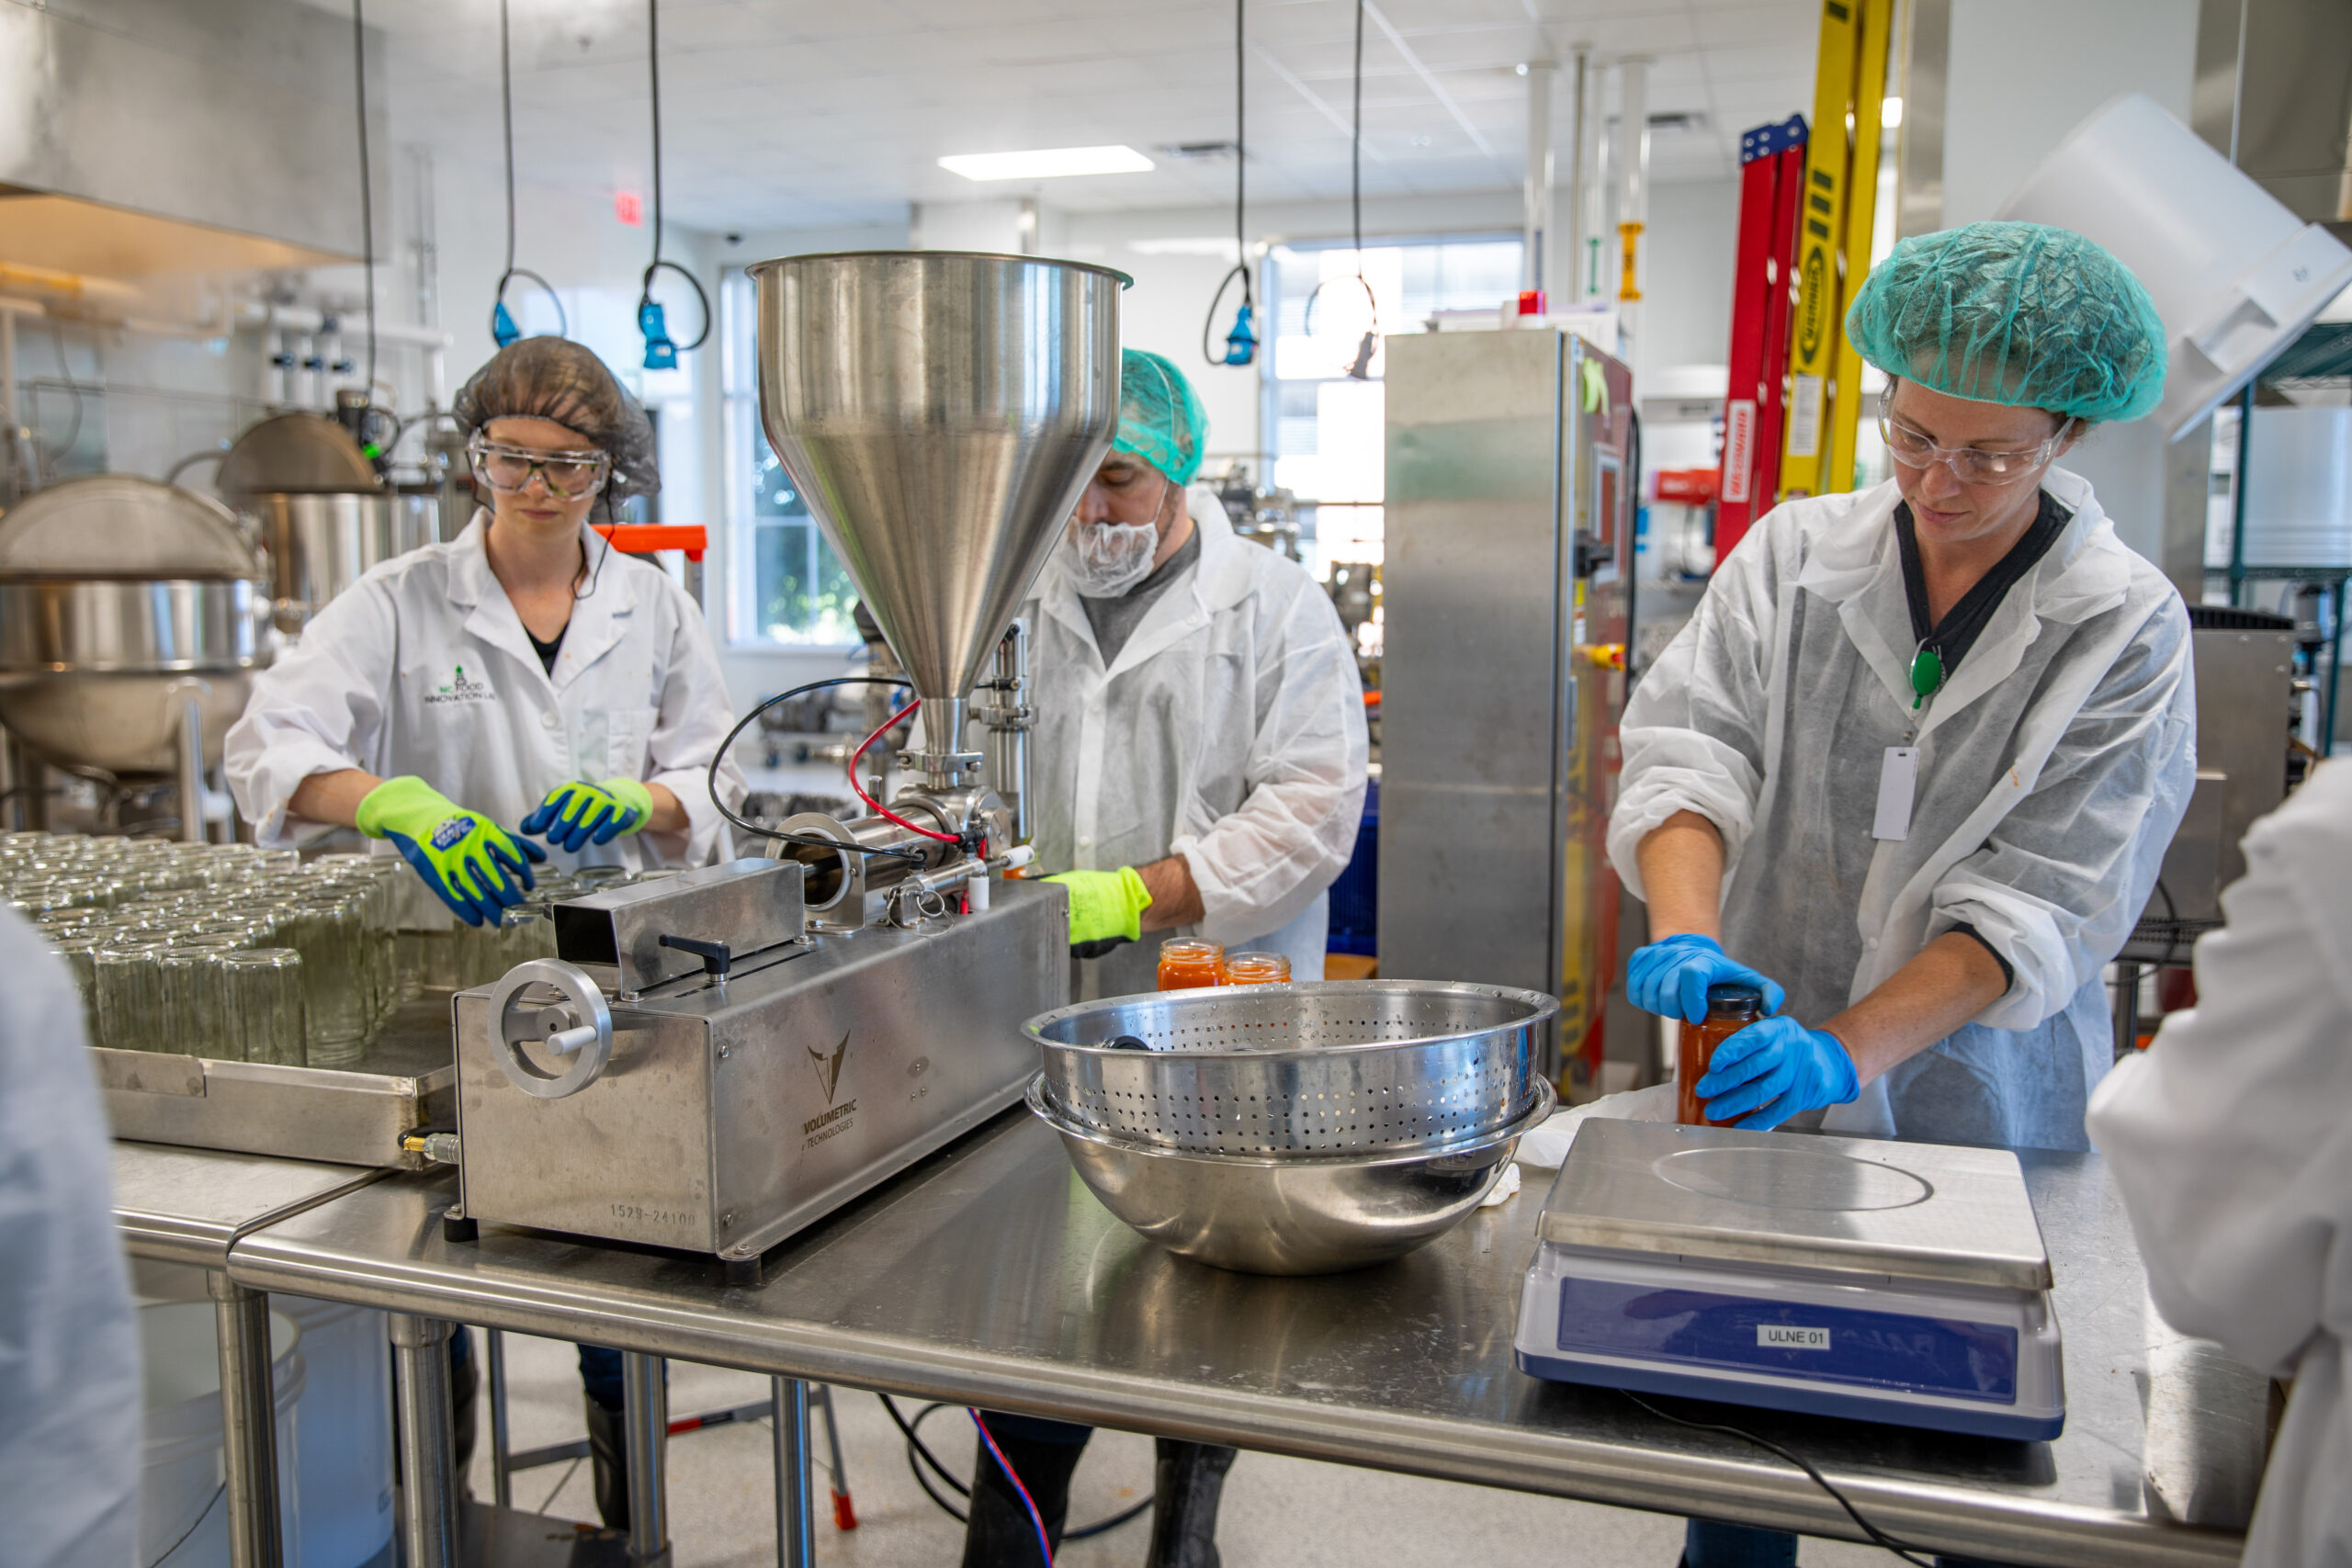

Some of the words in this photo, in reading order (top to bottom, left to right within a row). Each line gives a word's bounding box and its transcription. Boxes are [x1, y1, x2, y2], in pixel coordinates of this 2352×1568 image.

[456, 682, 483, 691] FOOD
[424, 693, 483, 704] INNOVATION
[804, 1099, 856, 1135] VOLUMETRIC
[807, 1118, 854, 1148] TECHNOLOGIES
[1769, 1329, 1805, 1343] ULNE
[1809, 1331, 1823, 1344] 01
